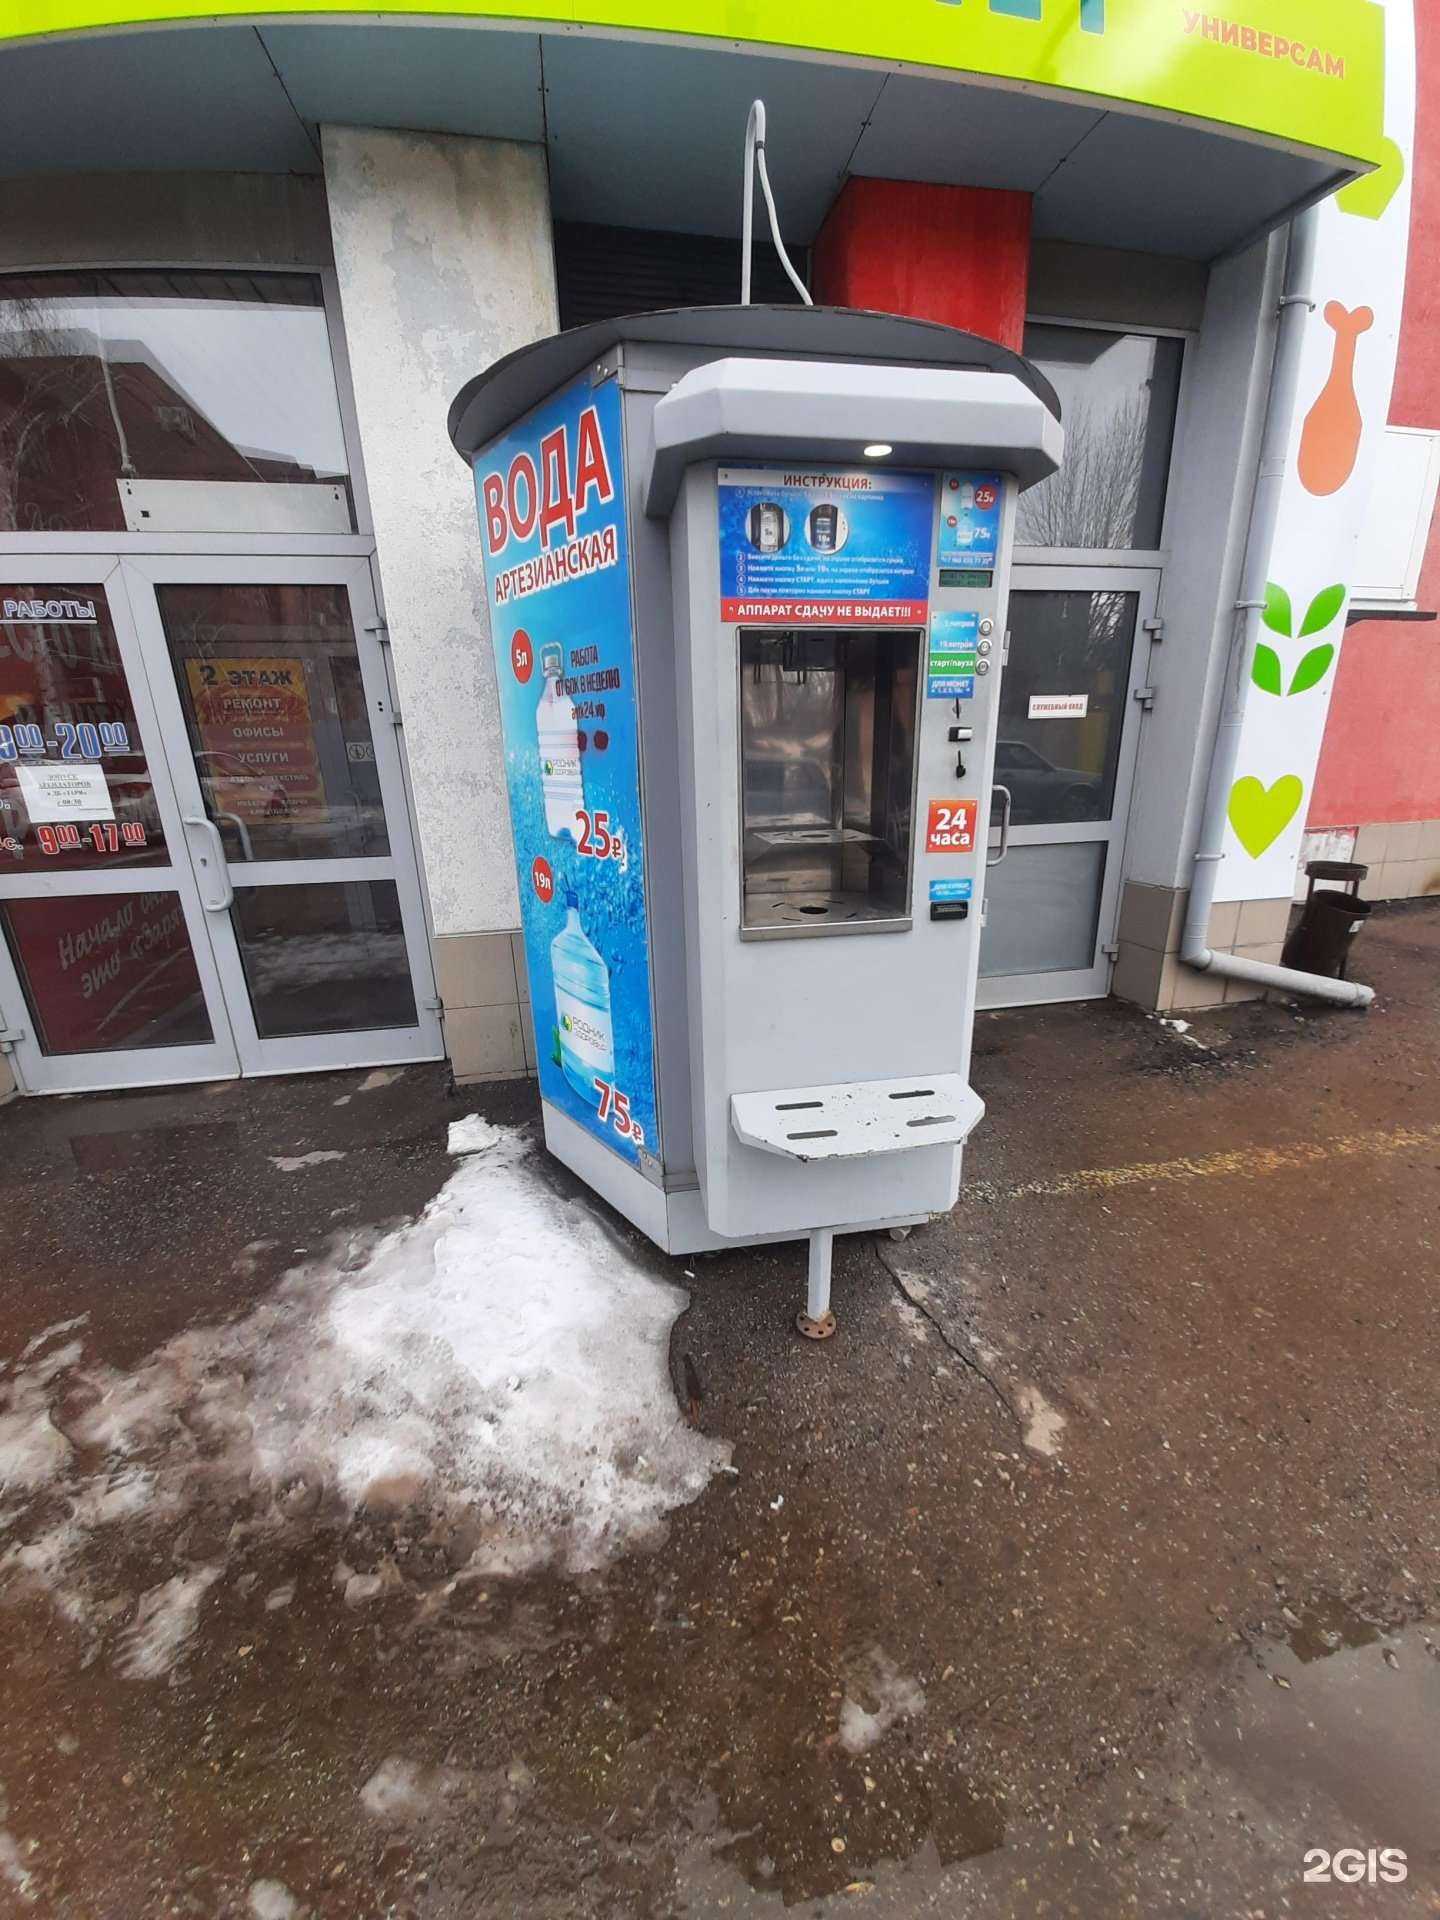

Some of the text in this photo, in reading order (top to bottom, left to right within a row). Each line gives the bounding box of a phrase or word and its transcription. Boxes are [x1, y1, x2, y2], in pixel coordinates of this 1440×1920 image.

[1181, 7, 1345, 80] УНИВЕРСАМ
[483, 405, 614, 557] ВОДА
[783, 475, 872, 490] ИНСТРУКЦИЯ:
[496, 524, 617, 605] АРТЕЗИАНСКАЯ
[4, 600, 97, 618] РАБОТЫ
[737, 605, 911, 618] АППАРАТ СДАЧУ НЕ ВЫДАЕТ!!!
[516, 649, 528, 667] 5л
[570, 645, 598, 668] РАБОТА
[200, 665, 293, 686] 2 ЭТАЖ
[587, 668, 621, 693] НЕДЕЛЮ
[224, 698, 281, 709] РЕМОНТ
[233, 727, 284, 738] ОФИСЫ
[238, 752, 289, 763] УСЛУГИ
[936, 808, 967, 830] 24
[931, 832, 970, 846] часа
[534, 872, 551, 890] 19л
[57, 902, 134, 971] Начало
